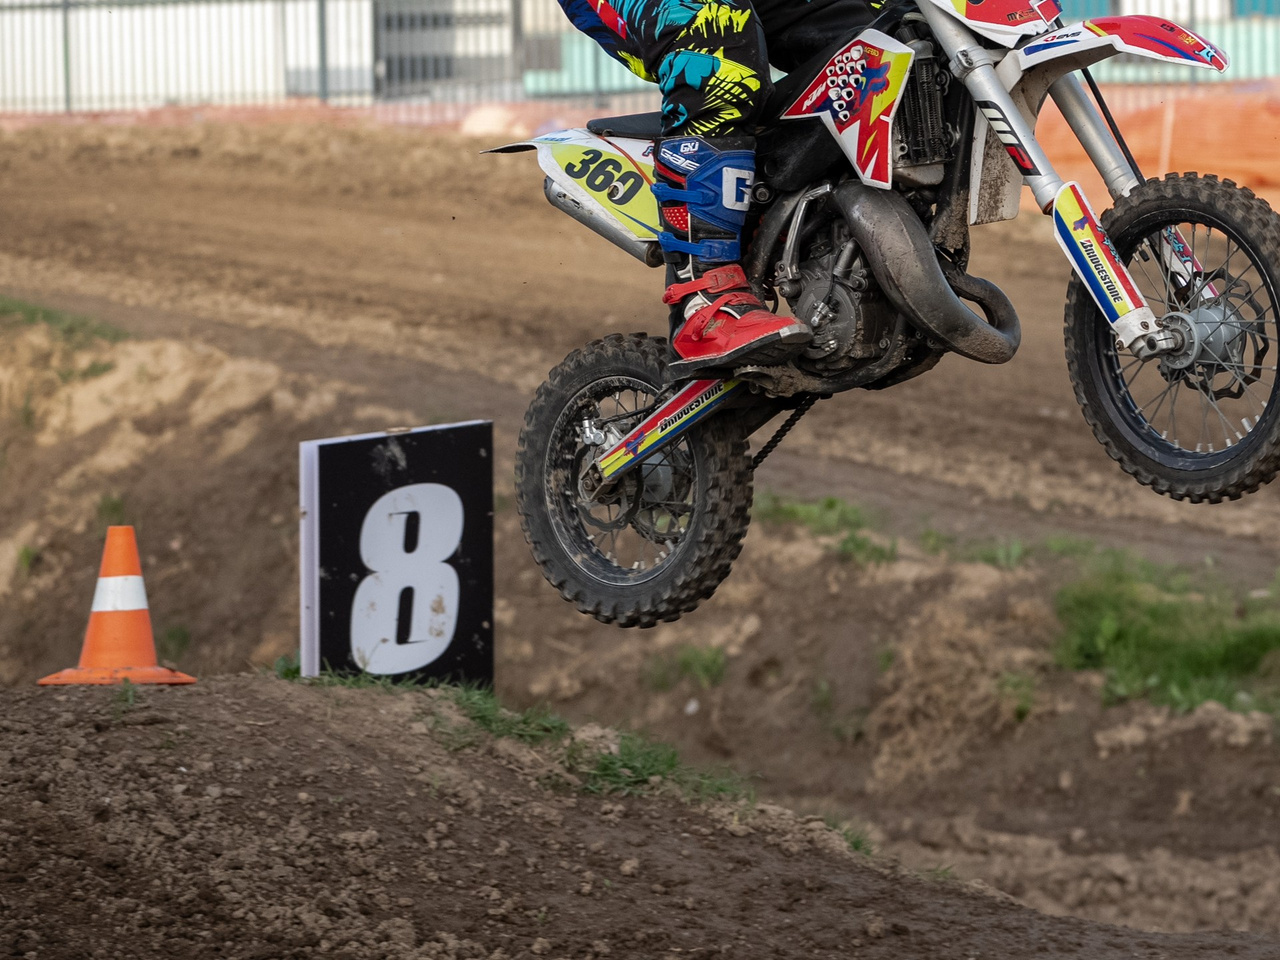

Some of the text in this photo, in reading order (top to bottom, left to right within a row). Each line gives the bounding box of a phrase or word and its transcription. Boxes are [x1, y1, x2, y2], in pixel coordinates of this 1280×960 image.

[802, 81, 827, 111] KTM
[680, 142, 699, 153] GXJ
[564, 149, 644, 206] 360
[1079, 239, 1124, 303] BRIDGESTONE
[660, 383, 725, 434] BRIDGESTONE
[350, 482, 464, 675] 8
